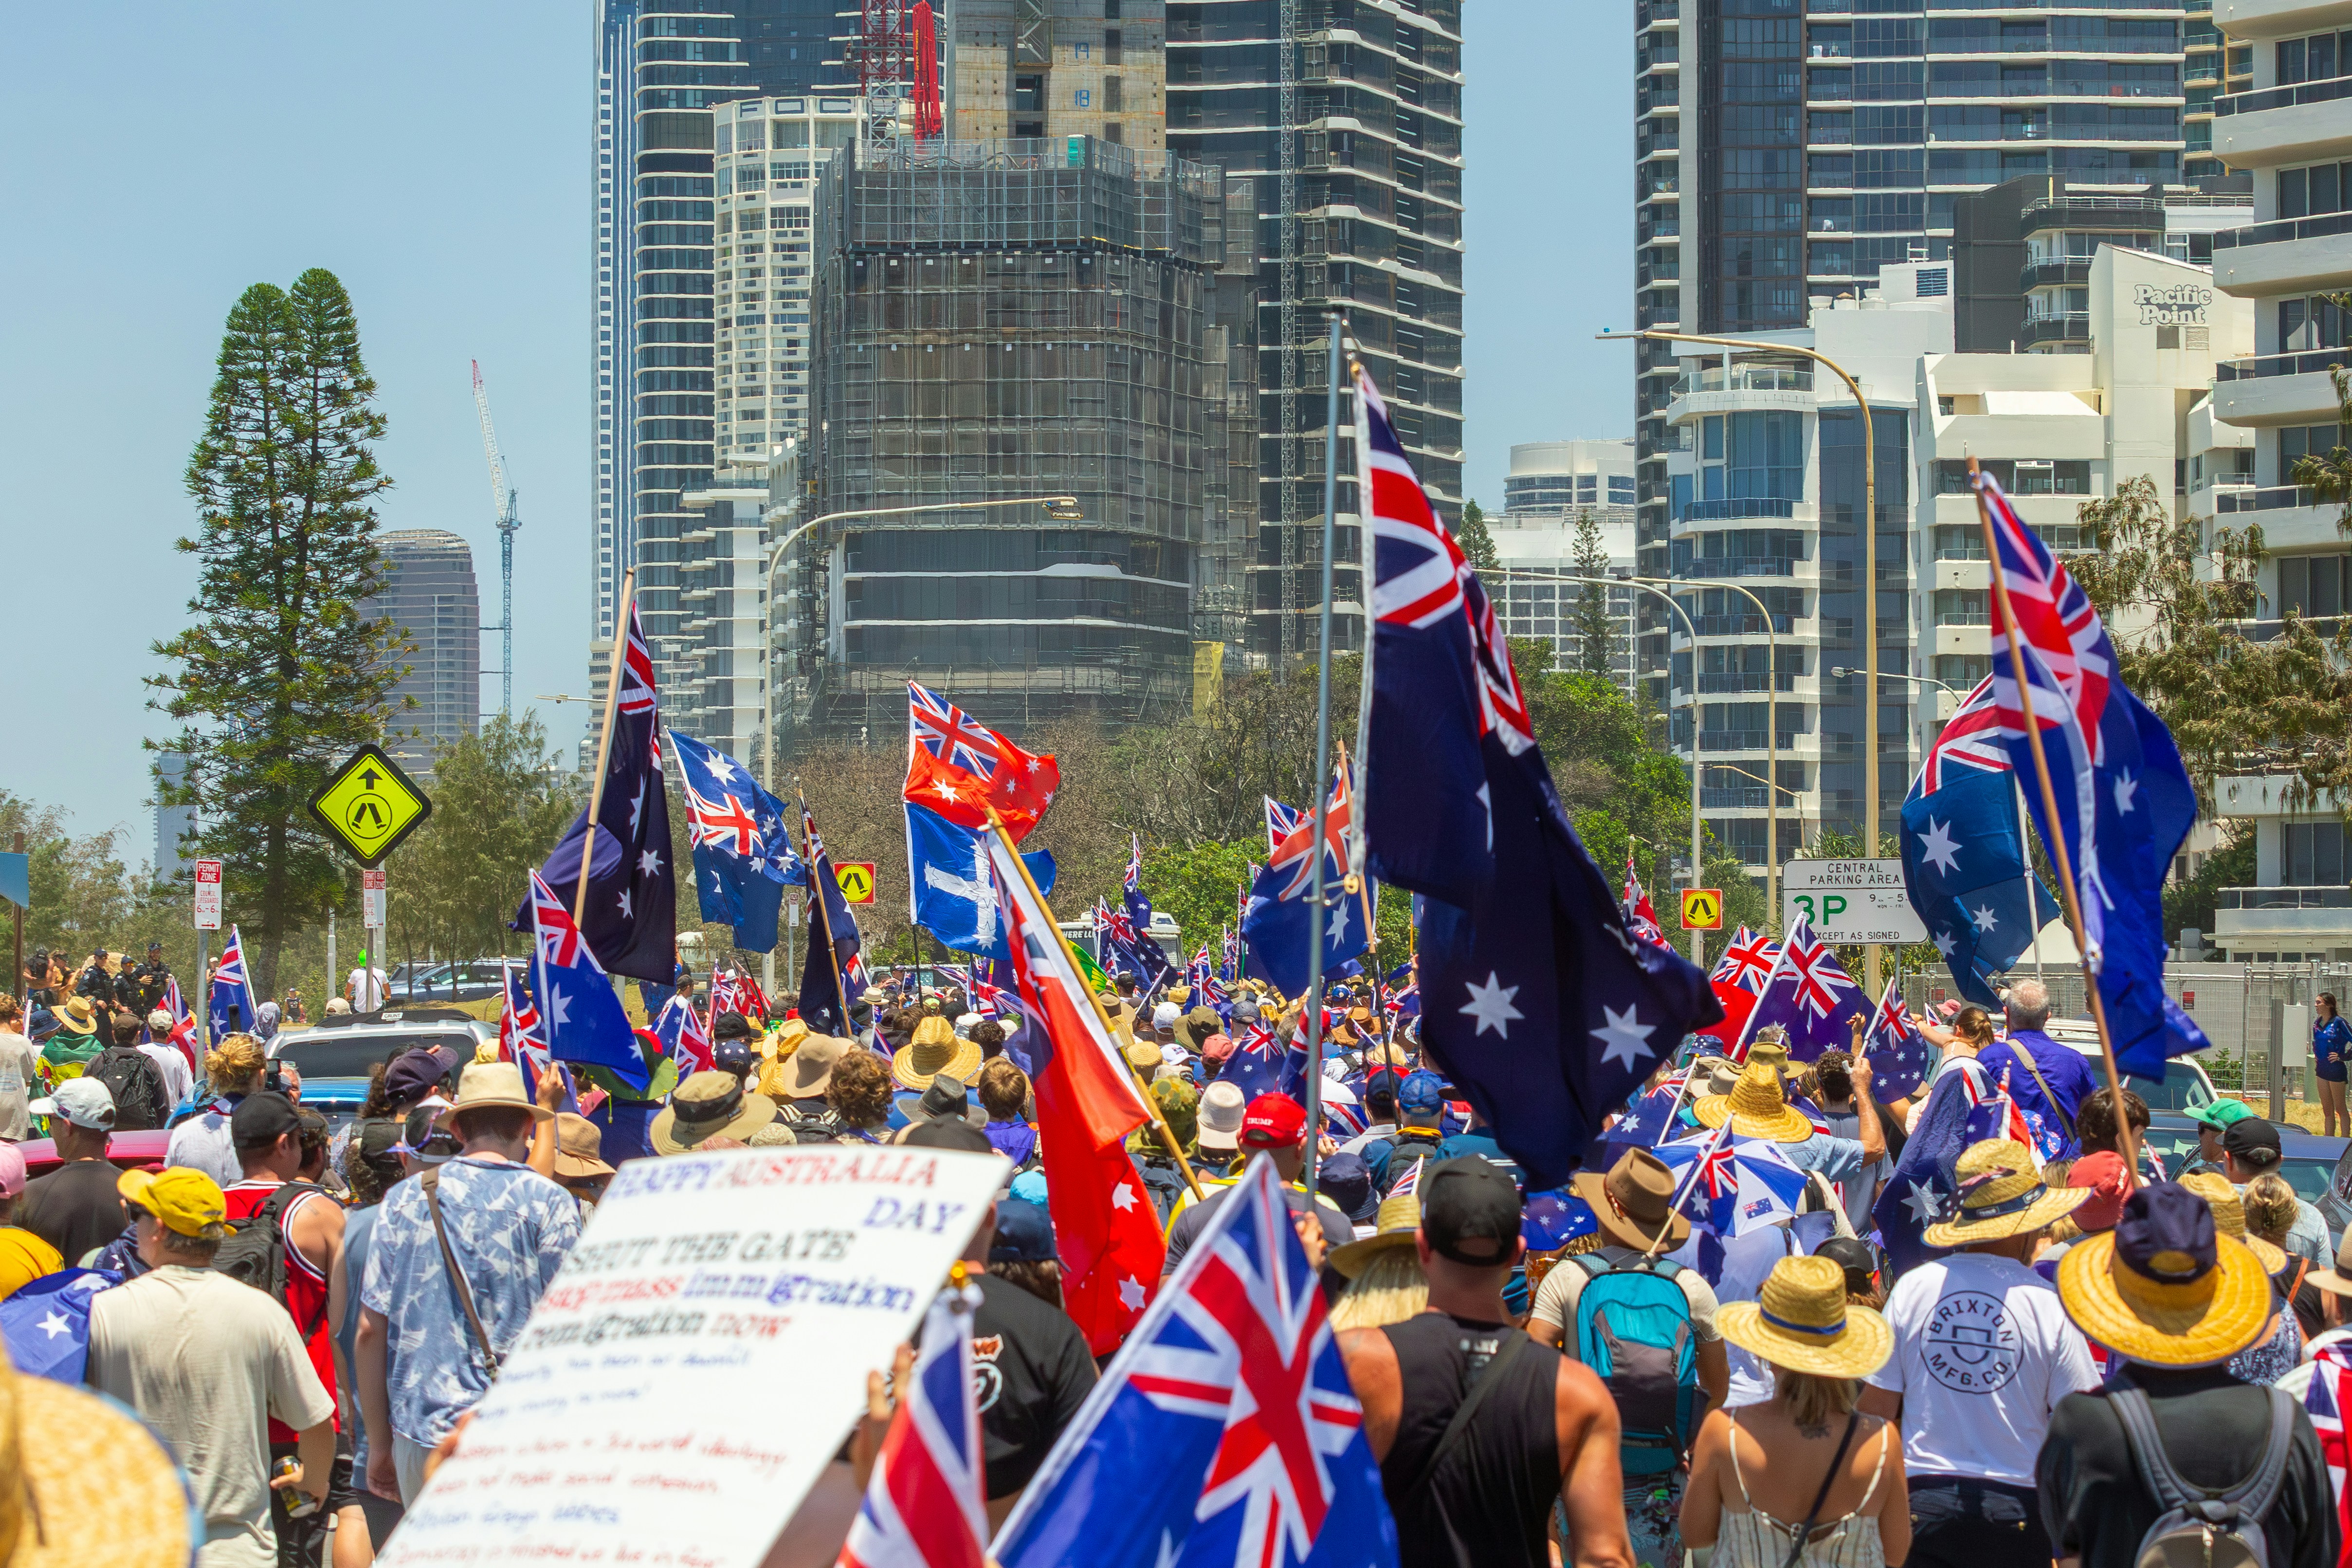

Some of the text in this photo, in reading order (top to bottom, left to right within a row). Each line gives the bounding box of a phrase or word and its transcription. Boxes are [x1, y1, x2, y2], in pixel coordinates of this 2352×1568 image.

[1075, 90, 1090, 107] 18
[2134, 284, 2212, 306] Pacific
[2140, 304, 2206, 325] Point
[199, 863, 220, 873] PERMIT
[200, 872, 217, 882] ZONE
[1827, 863, 1883, 873] CENTRAL
[1810, 875, 1900, 885] PARKING AREA
[1792, 895, 1847, 926] 3P
[1850, 931, 1862, 940] AS
[1247, 1117, 1274, 1126] TRUMP
[714, 1153, 939, 1188] AUSTRALIA
[861, 1196, 966, 1234] DAY
[563, 1229, 857, 1276] SHUT THE GATE
[682, 1269, 916, 1313] immigration
[1929, 1299, 2014, 1342] BRIXTON
